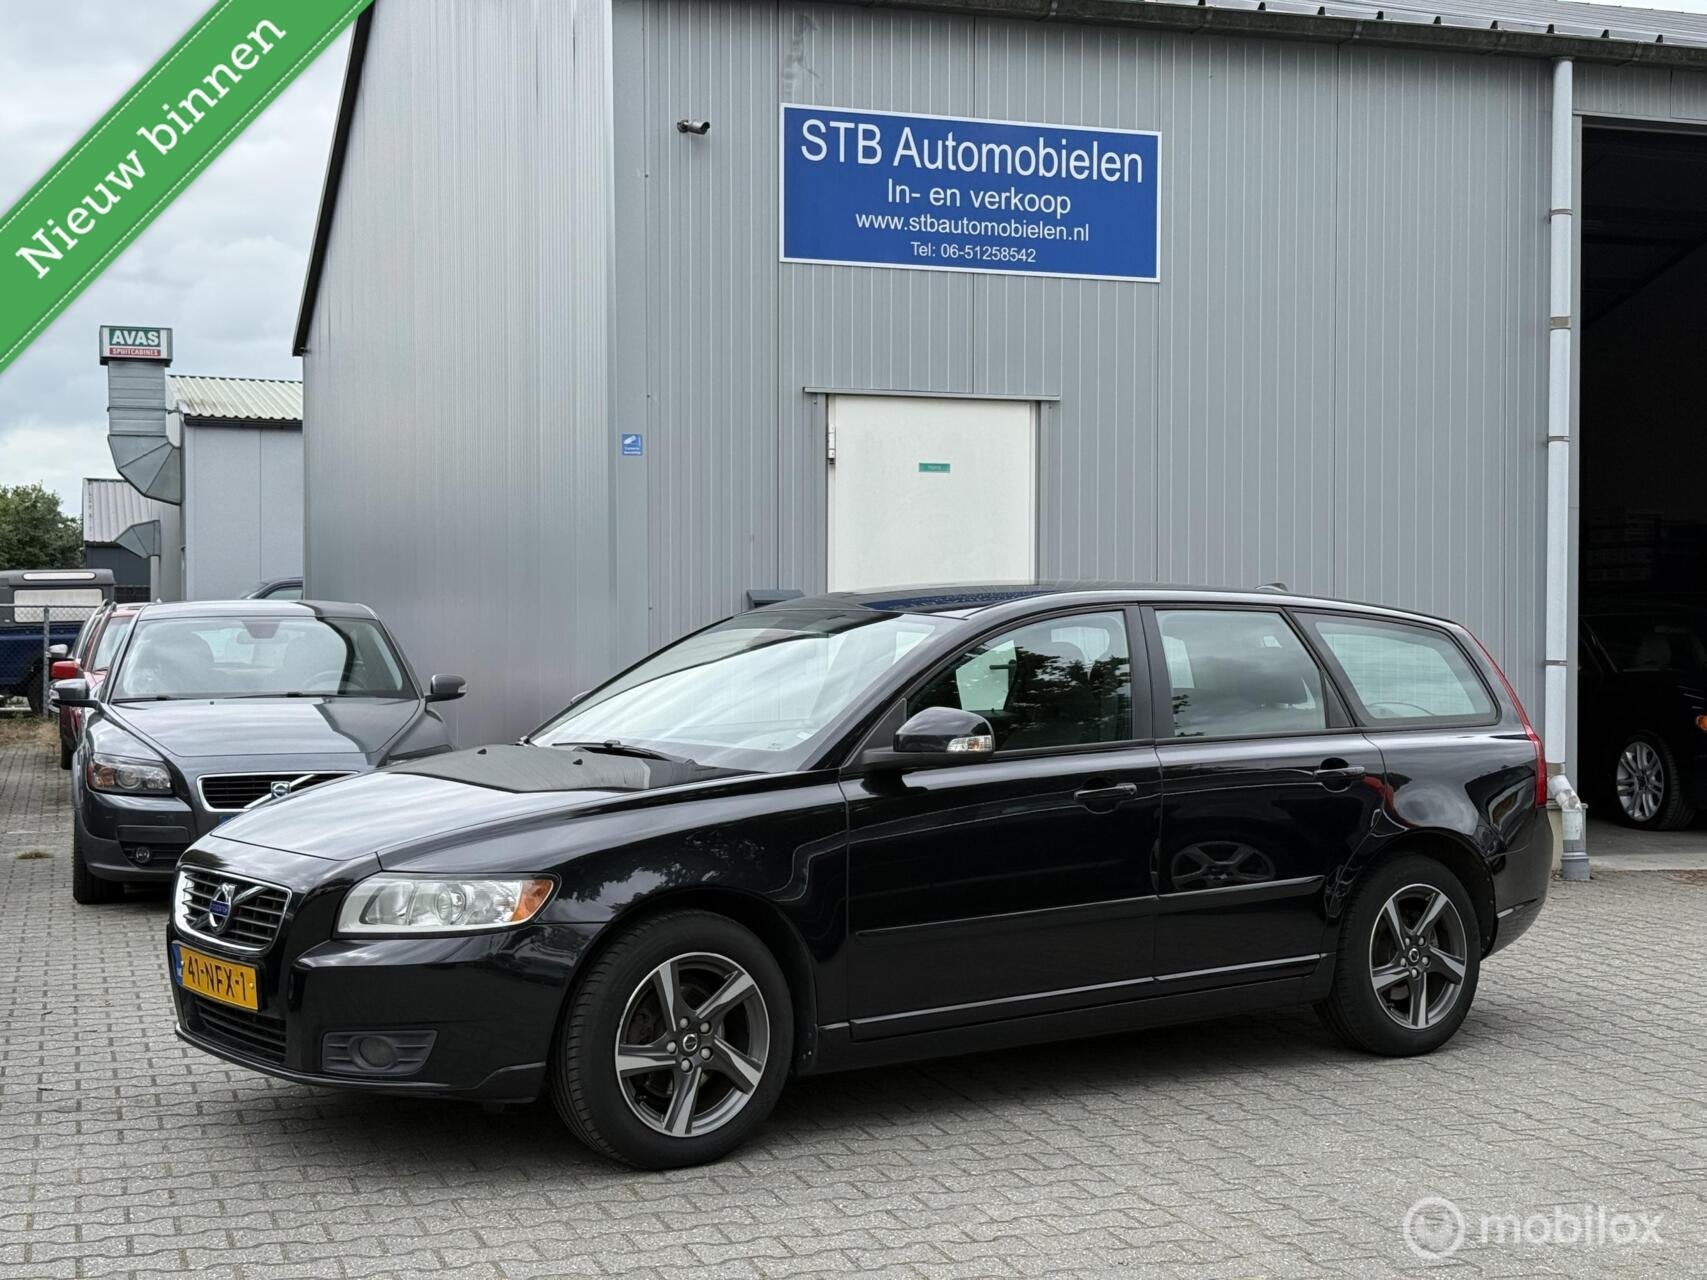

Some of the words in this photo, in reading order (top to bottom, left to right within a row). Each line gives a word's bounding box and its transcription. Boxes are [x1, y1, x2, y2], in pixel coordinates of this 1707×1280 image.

[800, 118, 882, 166] STB
[893, 125, 1143, 183] Automobielen
[888, 178, 921, 203] In-
[929, 186, 961, 207] en
[970, 186, 1071, 219] verkoop
[856, 211, 1090, 242] www.stbautomobielen.nl
[911, 241, 936, 257] Tel:
[940, 243, 1037, 263] 06-51258542
[111, 330, 159, 346] AVAS
[188, 955, 247, 1002] 41-NFX-1
